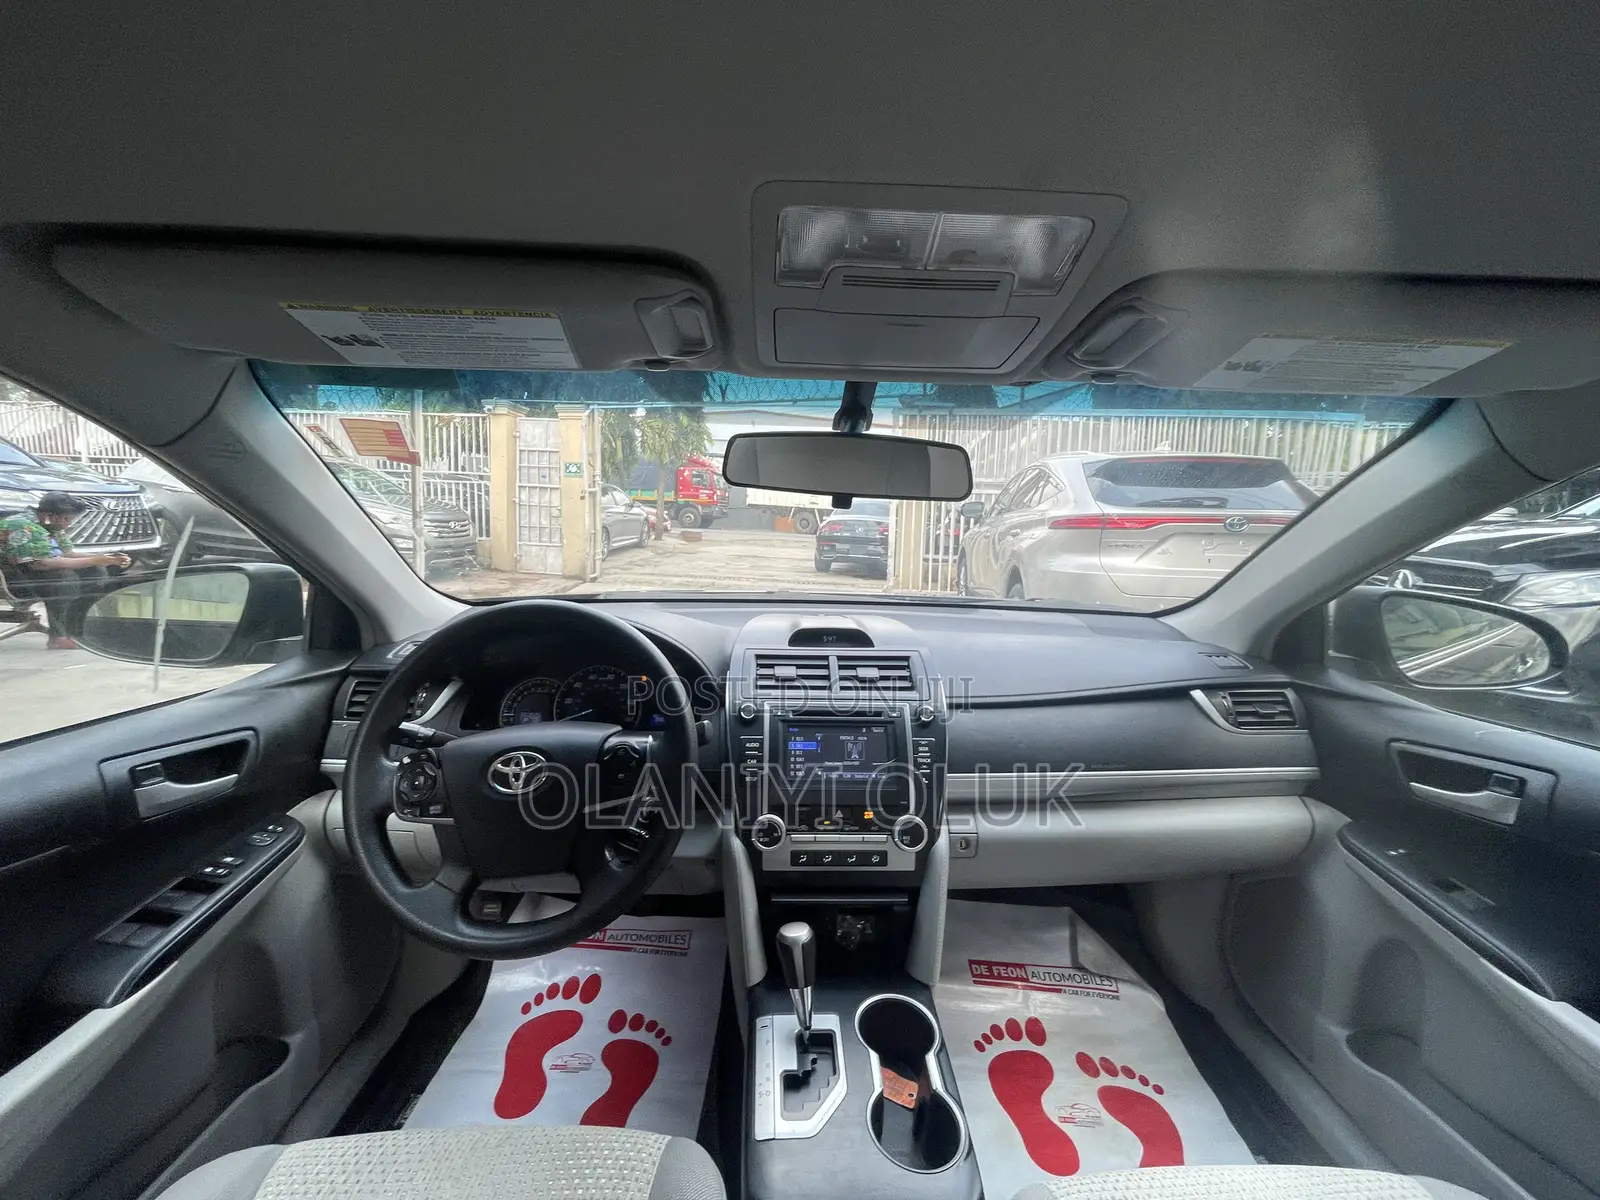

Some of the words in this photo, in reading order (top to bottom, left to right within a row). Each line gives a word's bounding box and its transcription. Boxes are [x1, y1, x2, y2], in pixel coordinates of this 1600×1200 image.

[607, 932, 687, 945] AUTOMOBILES
[971, 964, 990, 976] DE
[992, 965, 1028, 979] FEON
[1030, 969, 1113, 987] AUTOMOBILES
[1079, 990, 1092, 998] FOR
[1092, 991, 1121, 1001] EVERYONE
